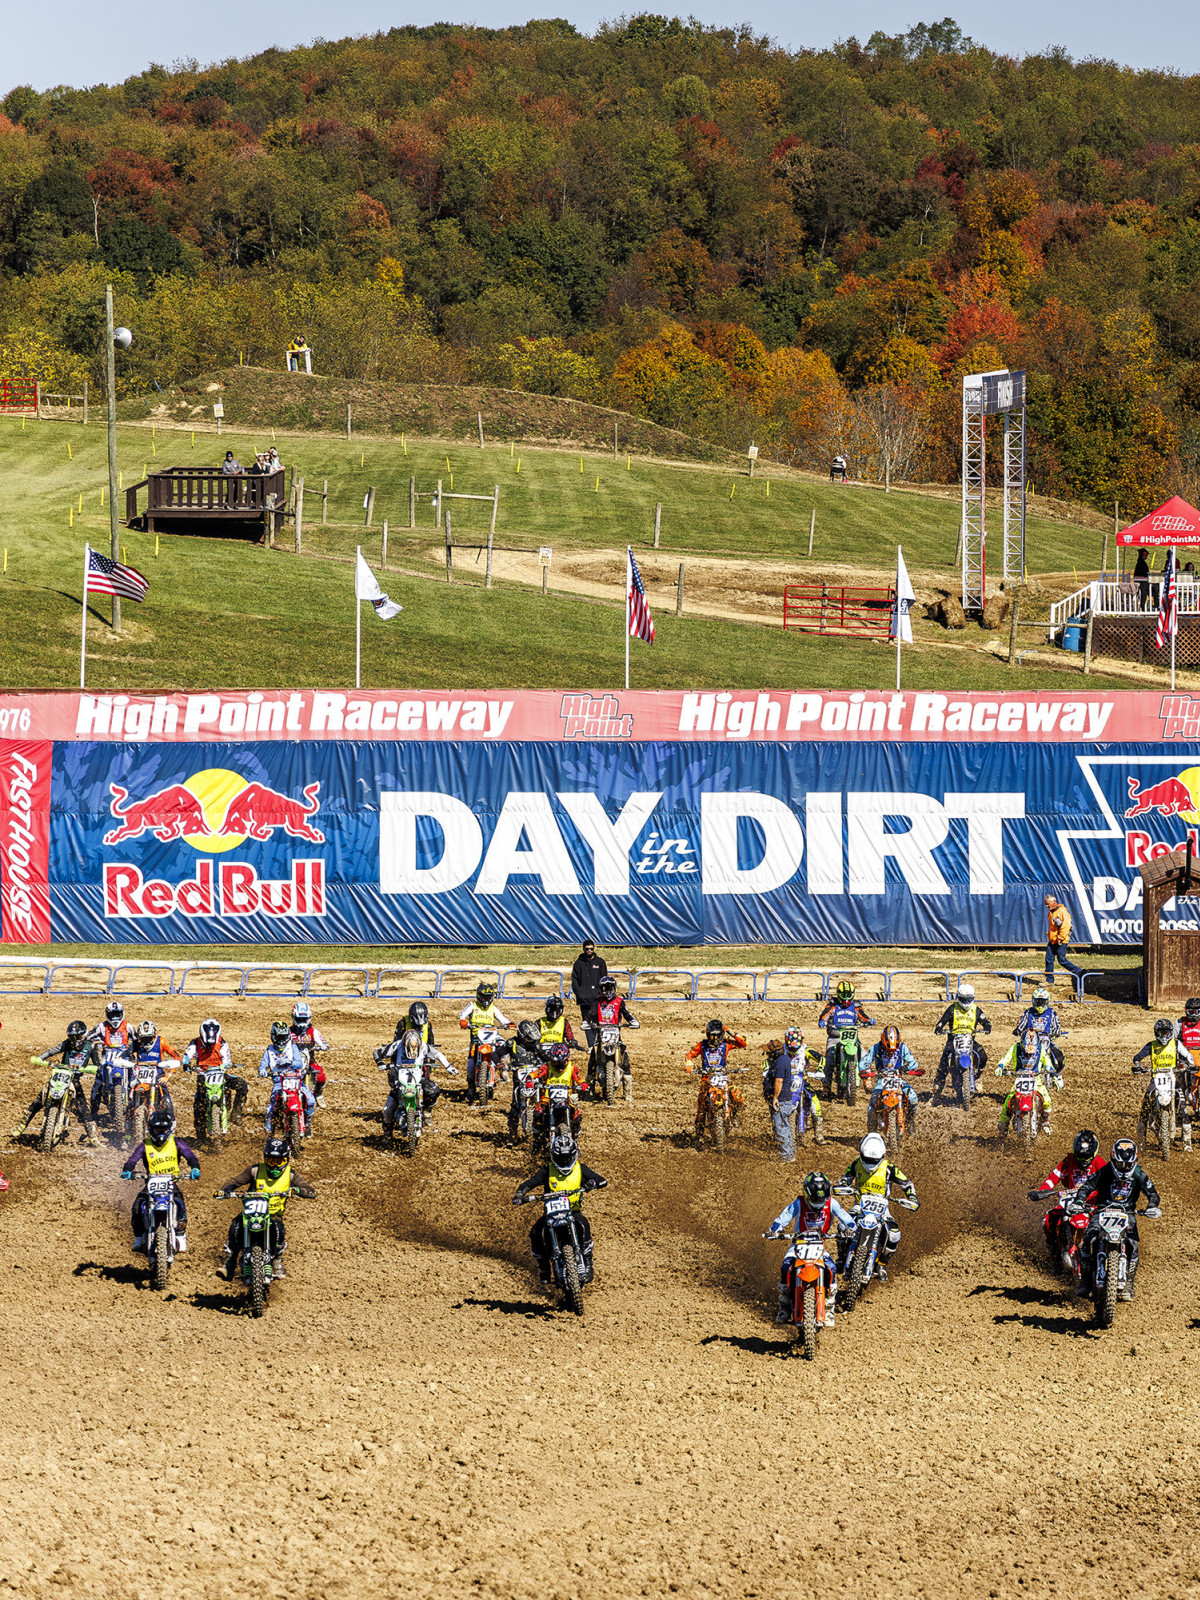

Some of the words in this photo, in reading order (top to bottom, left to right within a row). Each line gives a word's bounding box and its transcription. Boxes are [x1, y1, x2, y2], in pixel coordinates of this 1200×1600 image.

[1152, 515, 1187, 526] High
[1153, 522, 1195, 532] Point
[560, 694, 619, 718] High
[76, 693, 180, 742] High
[182, 692, 306, 734] Point
[310, 691, 514, 739] Raceway
[679, 691, 782, 741] High
[786, 692, 906, 732] Point
[910, 691, 1114, 739] Raceway
[564, 714, 634, 738] Point
[8, 752, 38, 931] FASTHOUSE
[379, 791, 664, 896] DAY
[641, 832, 697, 855] in
[701, 791, 1026, 896] DIRT
[1126, 829, 1199, 867] Red
[636, 855, 700, 874] the
[103, 860, 214, 918] Red
[219, 858, 327, 918] Bull
[1100, 919, 1199, 935] MOTOROSS
[483, 1031, 494, 1040] 7
[841, 1031, 856, 1040] 89
[1015, 1081, 1035, 1092] 437
[151, 1158, 165, 1168] STEEL
[149, 1180, 168, 1190] 213
[243, 1199, 269, 1214] 311
[862, 1200, 886, 1214] 255
[1102, 1216, 1126, 1228] 774
[798, 1243, 824, 1259] 316
